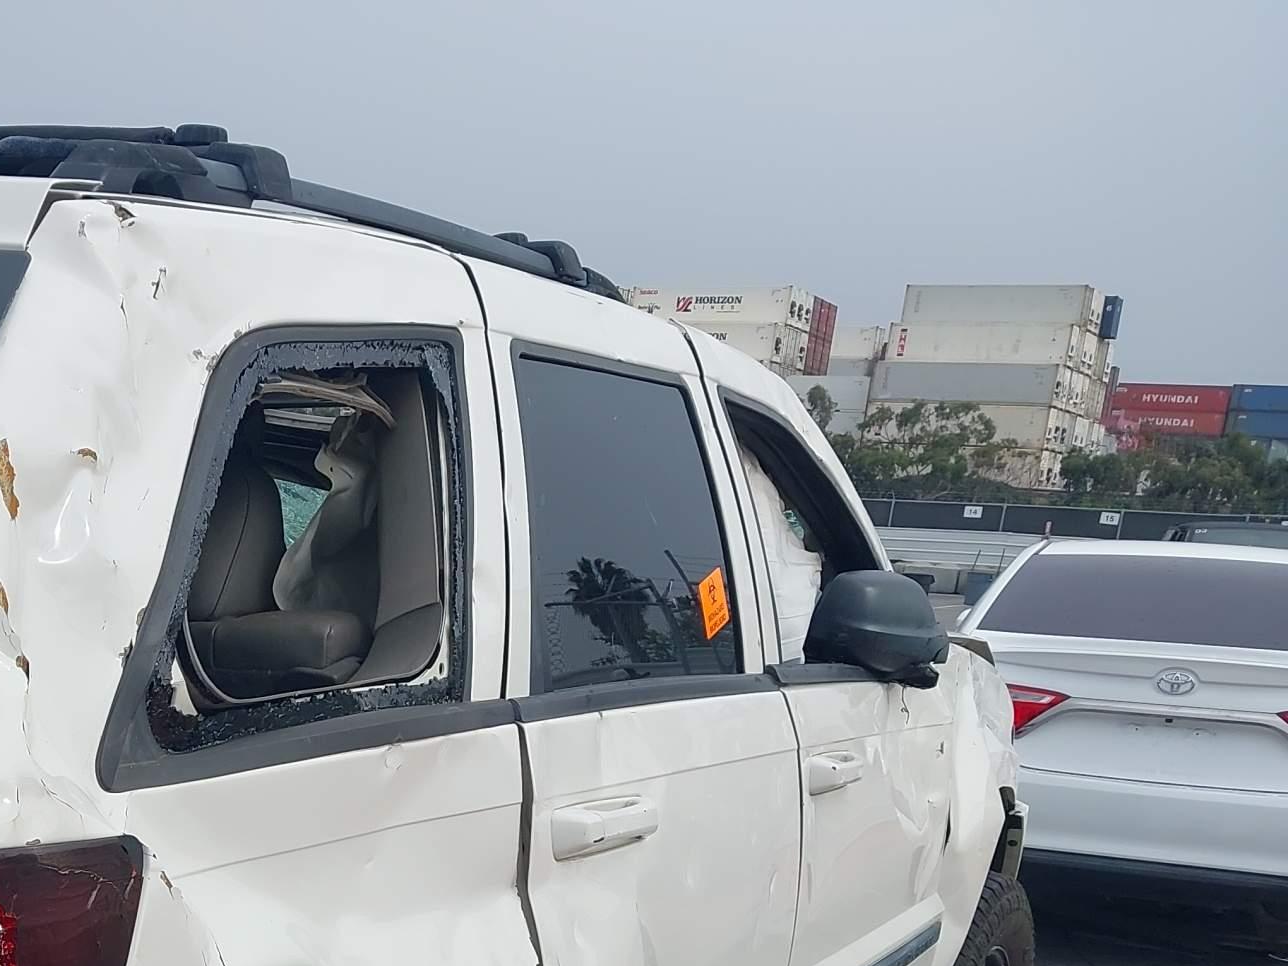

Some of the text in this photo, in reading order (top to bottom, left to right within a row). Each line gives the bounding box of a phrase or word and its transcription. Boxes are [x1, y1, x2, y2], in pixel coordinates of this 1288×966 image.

[695, 296, 743, 304] HORIZON
[1142, 394, 1199, 404] HYUNDAI
[1138, 416, 1195, 427] HYUNDAI
